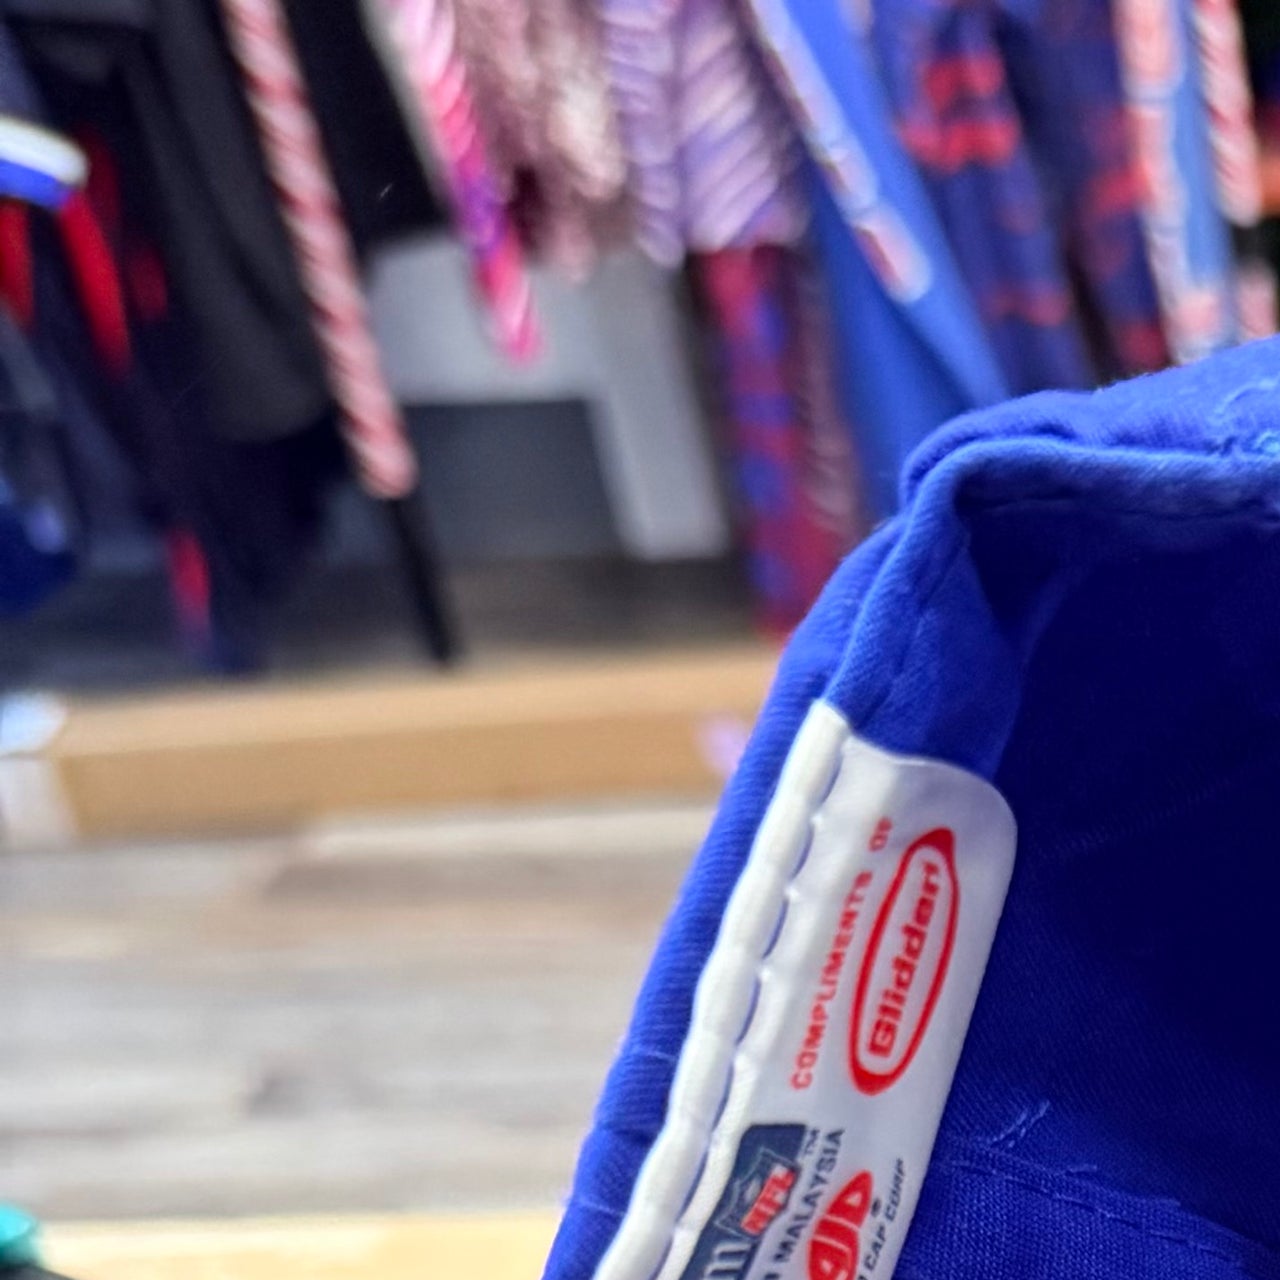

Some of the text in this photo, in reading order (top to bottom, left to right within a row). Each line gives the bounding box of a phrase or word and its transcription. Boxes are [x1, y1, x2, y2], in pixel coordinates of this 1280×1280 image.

[791, 817, 892, 1089] COMPLIMENTS OF
[868, 862, 940, 1056] Glidden
[741, 1169, 795, 1235] NFL
[774, 1130, 845, 1262] MALAYSIA
[864, 1226, 888, 1271] CAP
[885, 1157, 906, 1223] CORP
